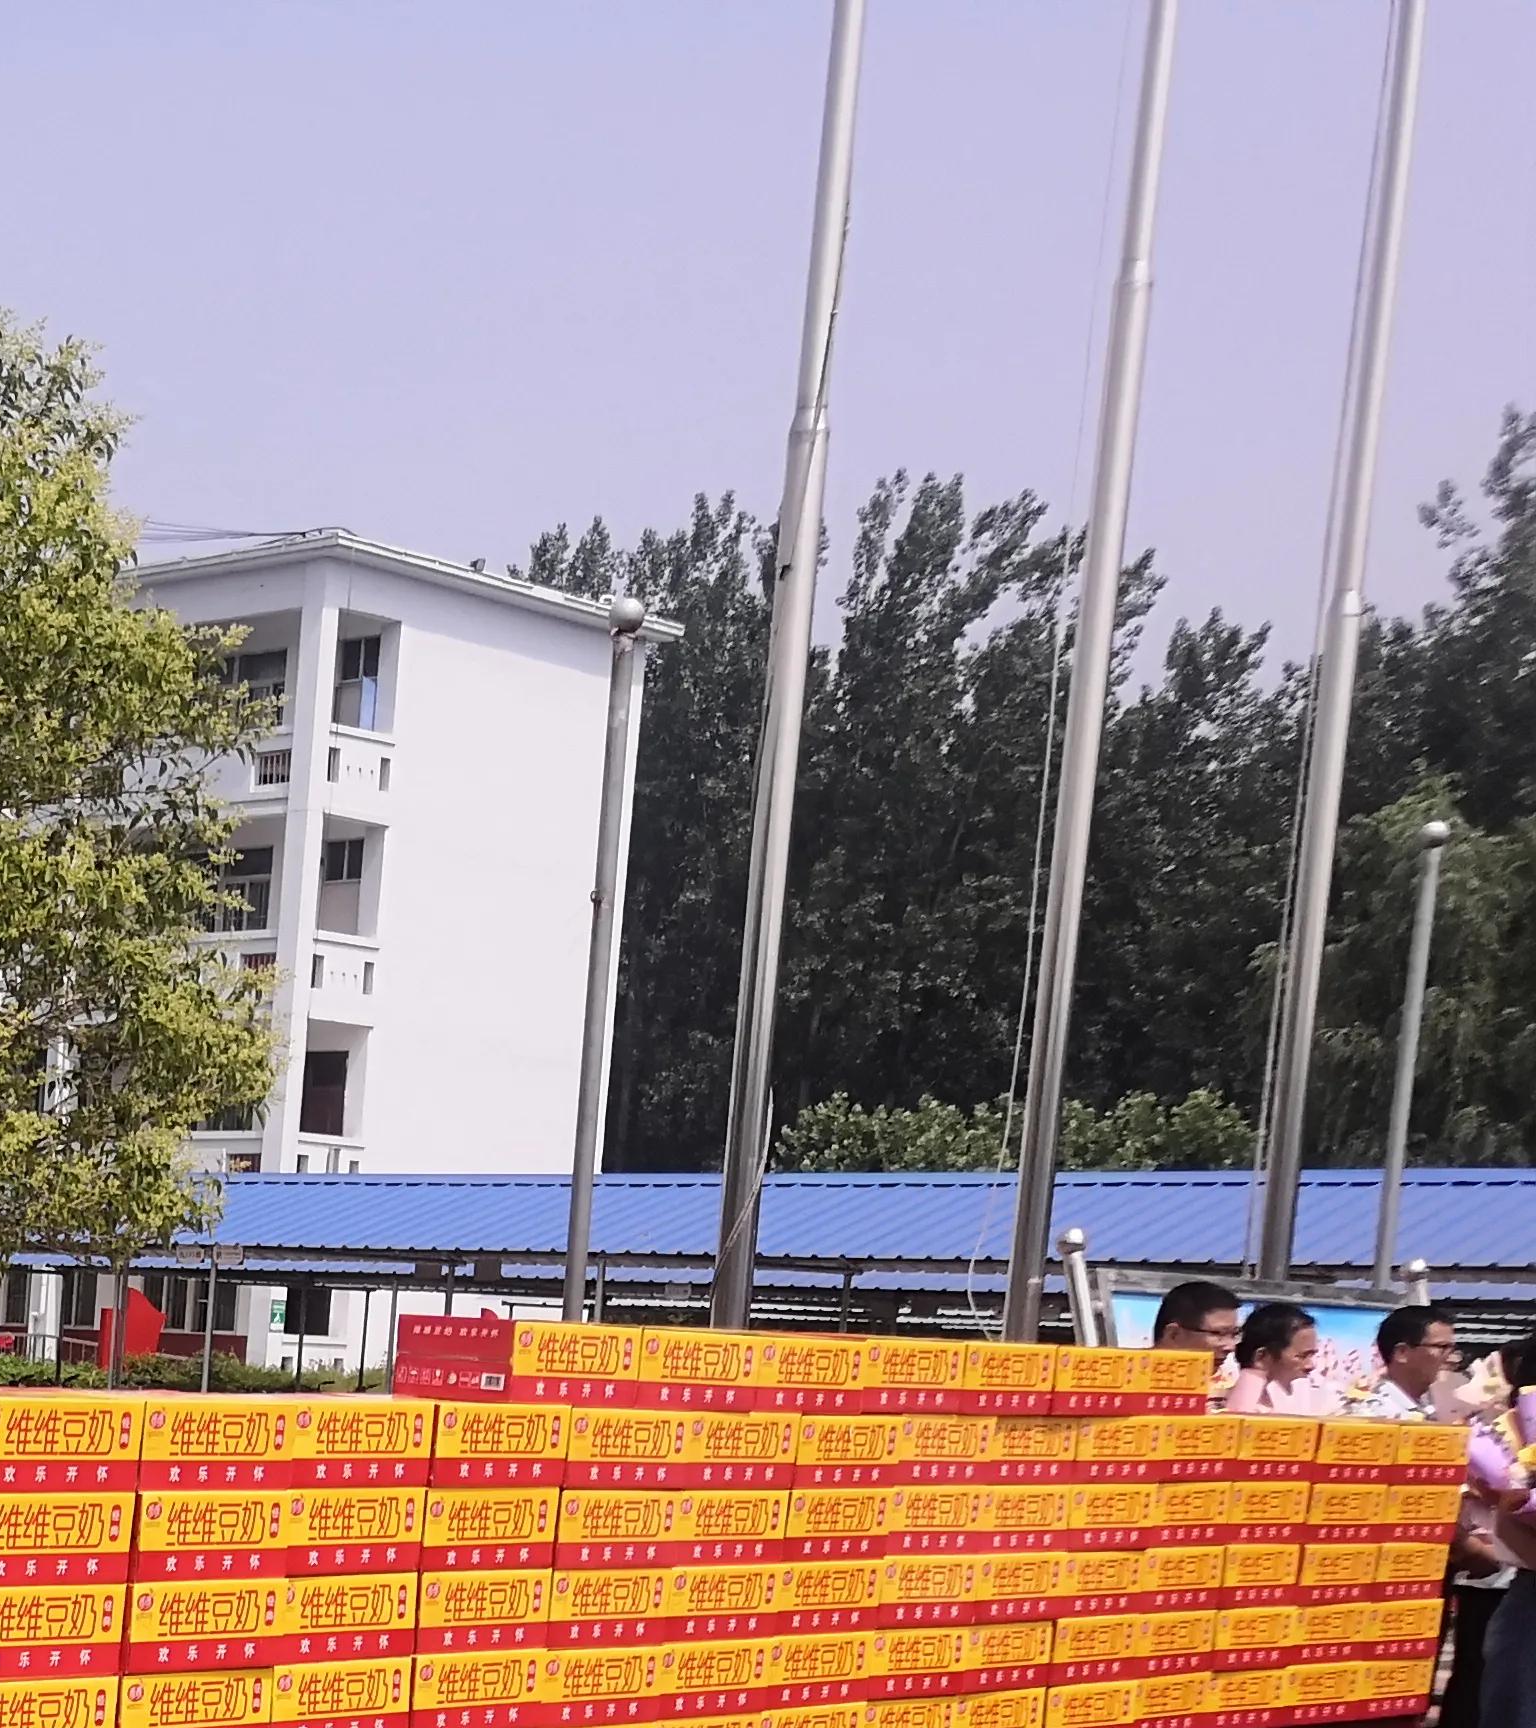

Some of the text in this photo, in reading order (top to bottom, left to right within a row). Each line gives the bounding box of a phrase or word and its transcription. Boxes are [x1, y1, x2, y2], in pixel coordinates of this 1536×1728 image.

[534, 1331, 622, 1376] 维维豆奶
[168, 1410, 272, 1456] 维维豆奶
[458, 1411, 549, 1454] 维维豆奶
[306, 1496, 402, 1541] 维维豆奶
[581, 1498, 663, 1539] 维维豆奶
[156, 1588, 262, 1637] 维维豆奶
[442, 1578, 531, 1623] 维维豆奶
[295, 1668, 391, 1716] 维维豆奶
[561, 1654, 645, 1698] 维维豆奶
